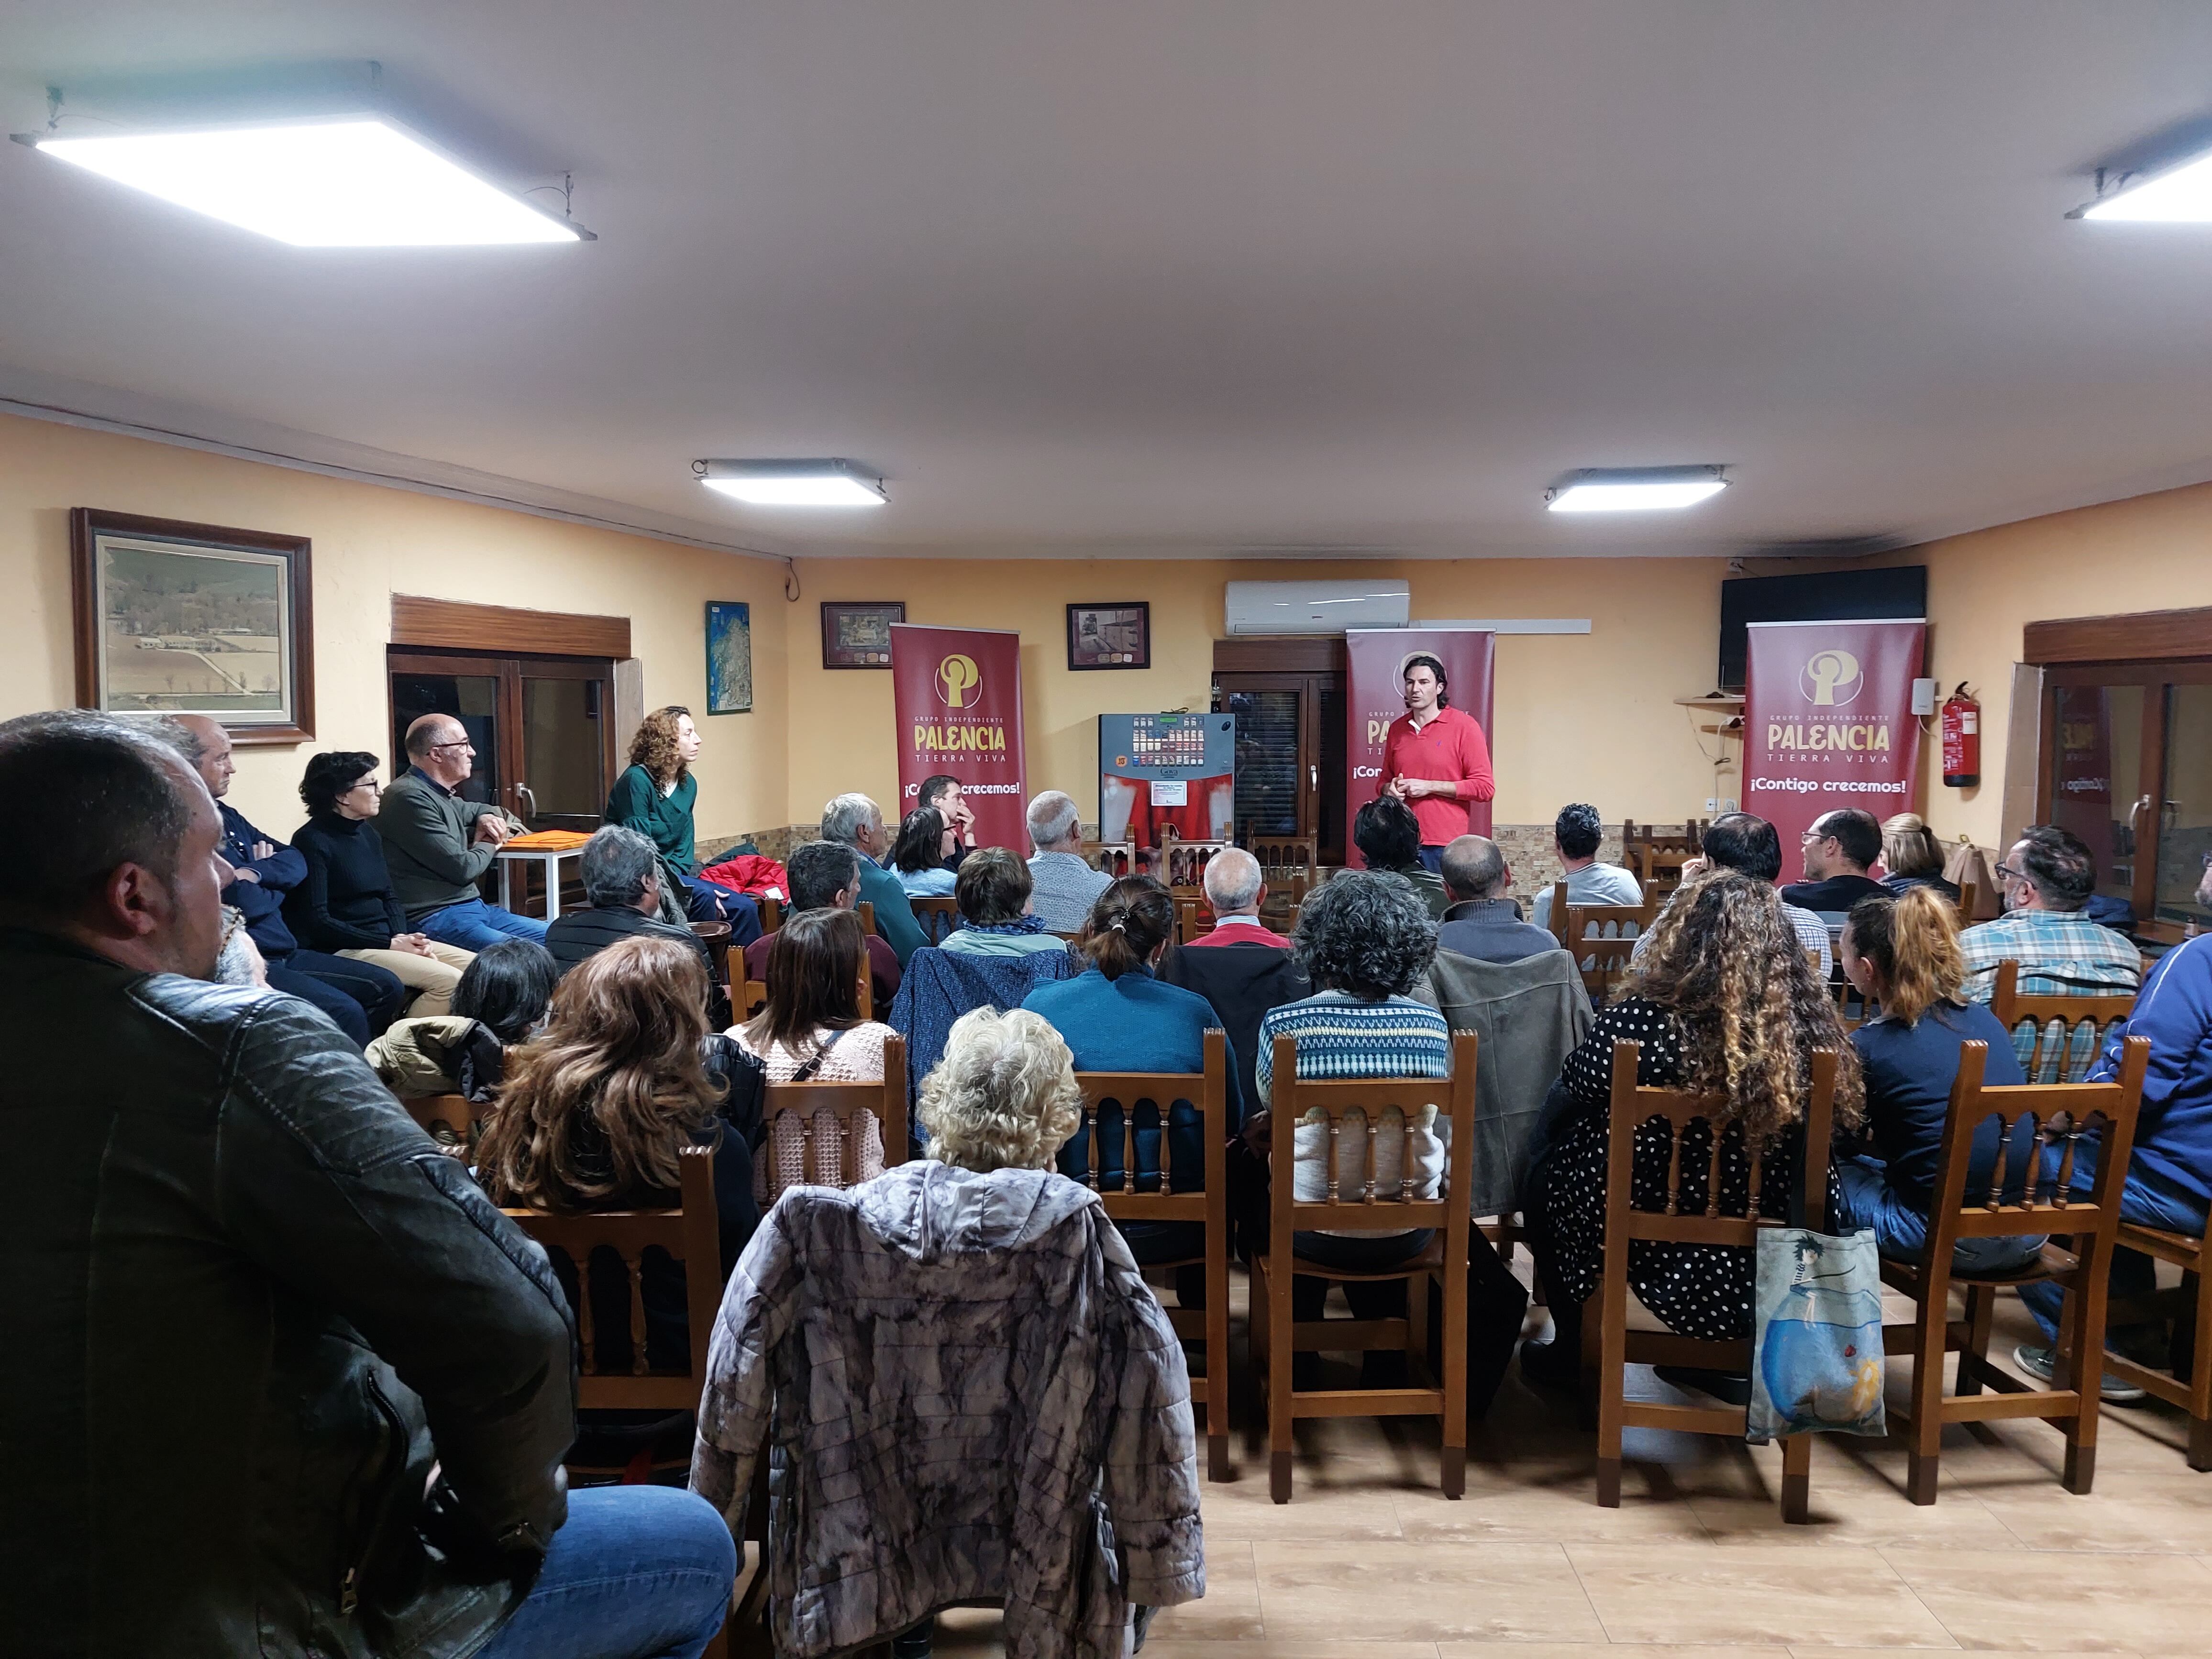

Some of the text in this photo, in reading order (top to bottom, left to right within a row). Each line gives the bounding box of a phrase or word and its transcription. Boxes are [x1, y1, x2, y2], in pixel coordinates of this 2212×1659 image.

[914, 725, 1006, 751] PALENCIA
[1768, 724, 1890, 752] PALENCIA
[976, 754, 1006, 763] VIVA
[1767, 754, 1888, 763] TIERRA VIVA
[961, 782, 1020, 795] crecemos!
[1751, 777, 1906, 794] ¡Contigo crecemos!
